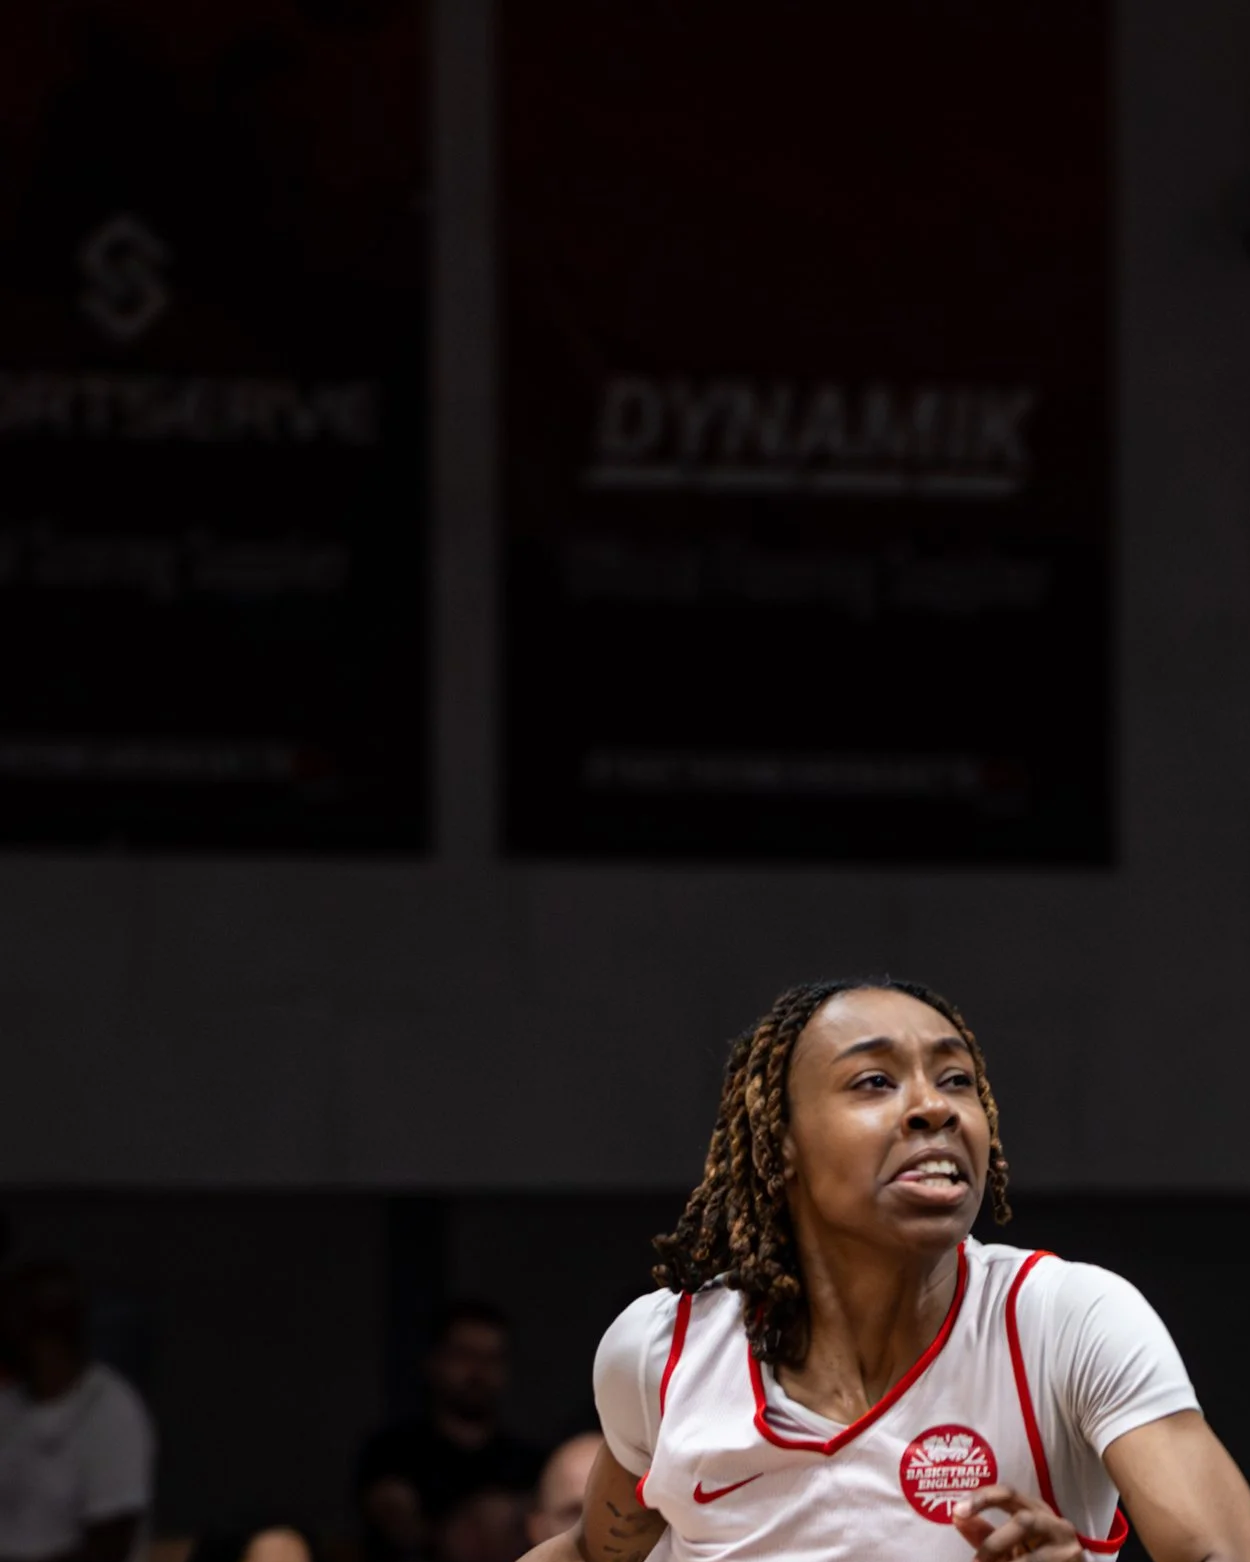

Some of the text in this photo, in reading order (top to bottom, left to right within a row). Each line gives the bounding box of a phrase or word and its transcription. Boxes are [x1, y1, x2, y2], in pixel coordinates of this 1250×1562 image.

[597, 376, 1037, 458] DYNAMIK
[905, 1465, 991, 1480] BASKETBALL
[917, 1478, 980, 1491] ENGLAND
